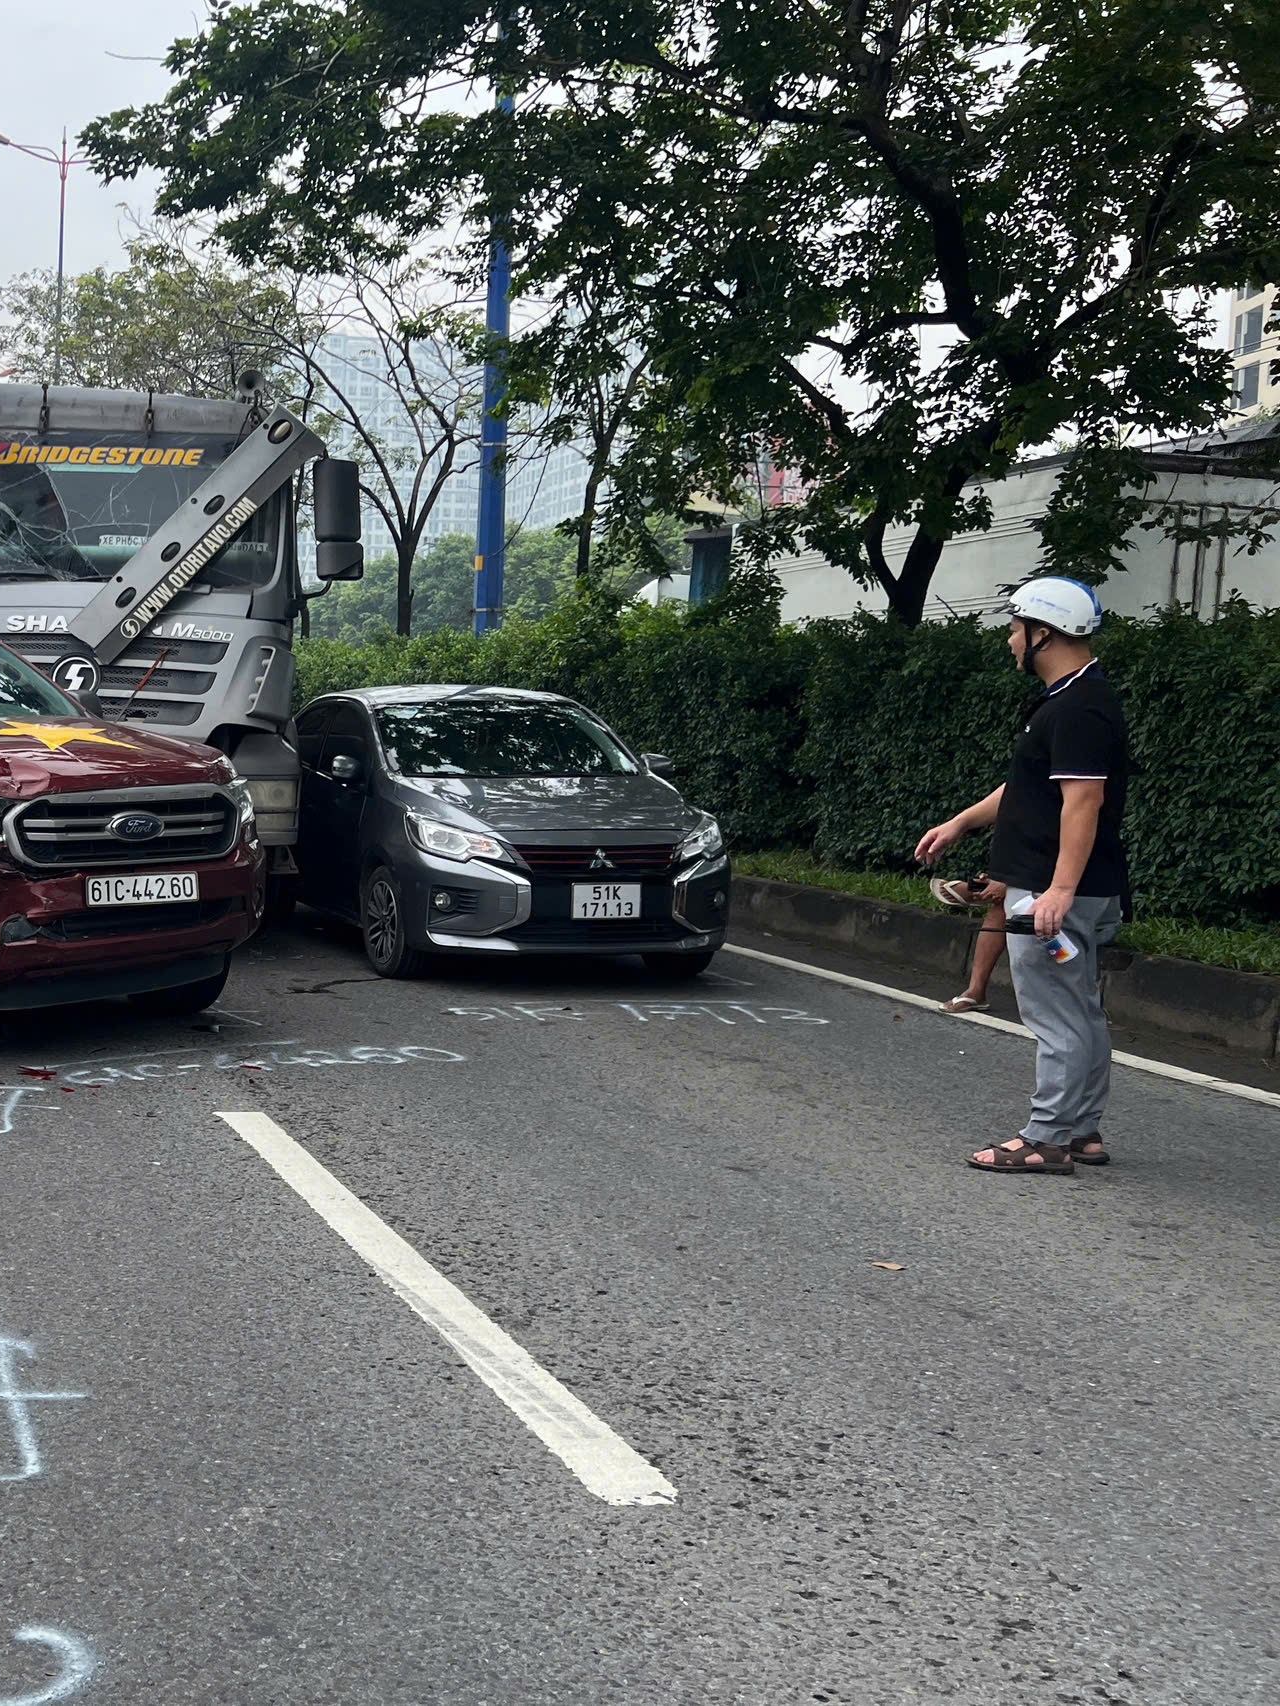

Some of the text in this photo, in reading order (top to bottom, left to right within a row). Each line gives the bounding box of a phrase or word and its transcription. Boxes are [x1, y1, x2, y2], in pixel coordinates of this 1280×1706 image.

[170, 622, 234, 642] M3000
[125, 819, 153, 834] Ford
[592, 885, 621, 901] 51K
[581, 901, 634, 917] 171.13
